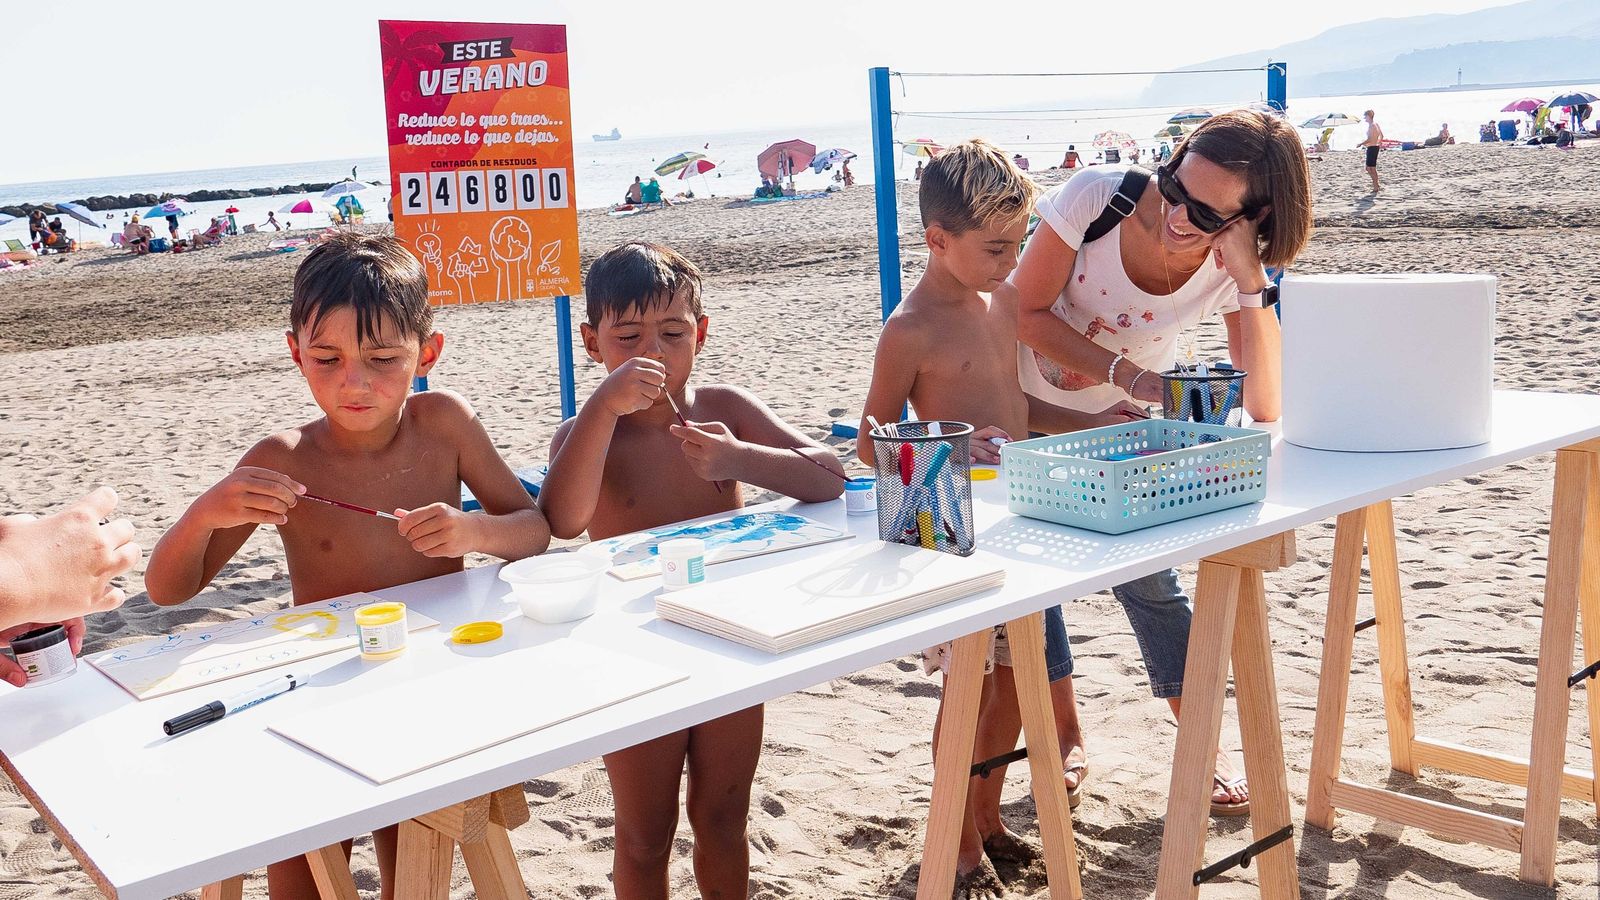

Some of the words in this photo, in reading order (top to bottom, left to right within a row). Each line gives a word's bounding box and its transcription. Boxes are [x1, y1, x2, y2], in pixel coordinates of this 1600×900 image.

[452, 40, 502, 61] ESTE
[419, 60, 548, 97] VERANO
[398, 113, 458, 128] Reduce
[460, 112, 476, 126] lo
[479, 113, 508, 130] que
[510, 112, 563, 126] traes...
[405, 130, 462, 145] reduce
[464, 130, 480, 144] lo
[483, 131, 512, 147] que
[514, 129, 559, 146] dejas.
[431, 160, 478, 168] CONTADOR
[480, 159, 491, 167] DE
[493, 158, 538, 166] RESIDUOS
[540, 276, 570, 285] ALMERÍA
